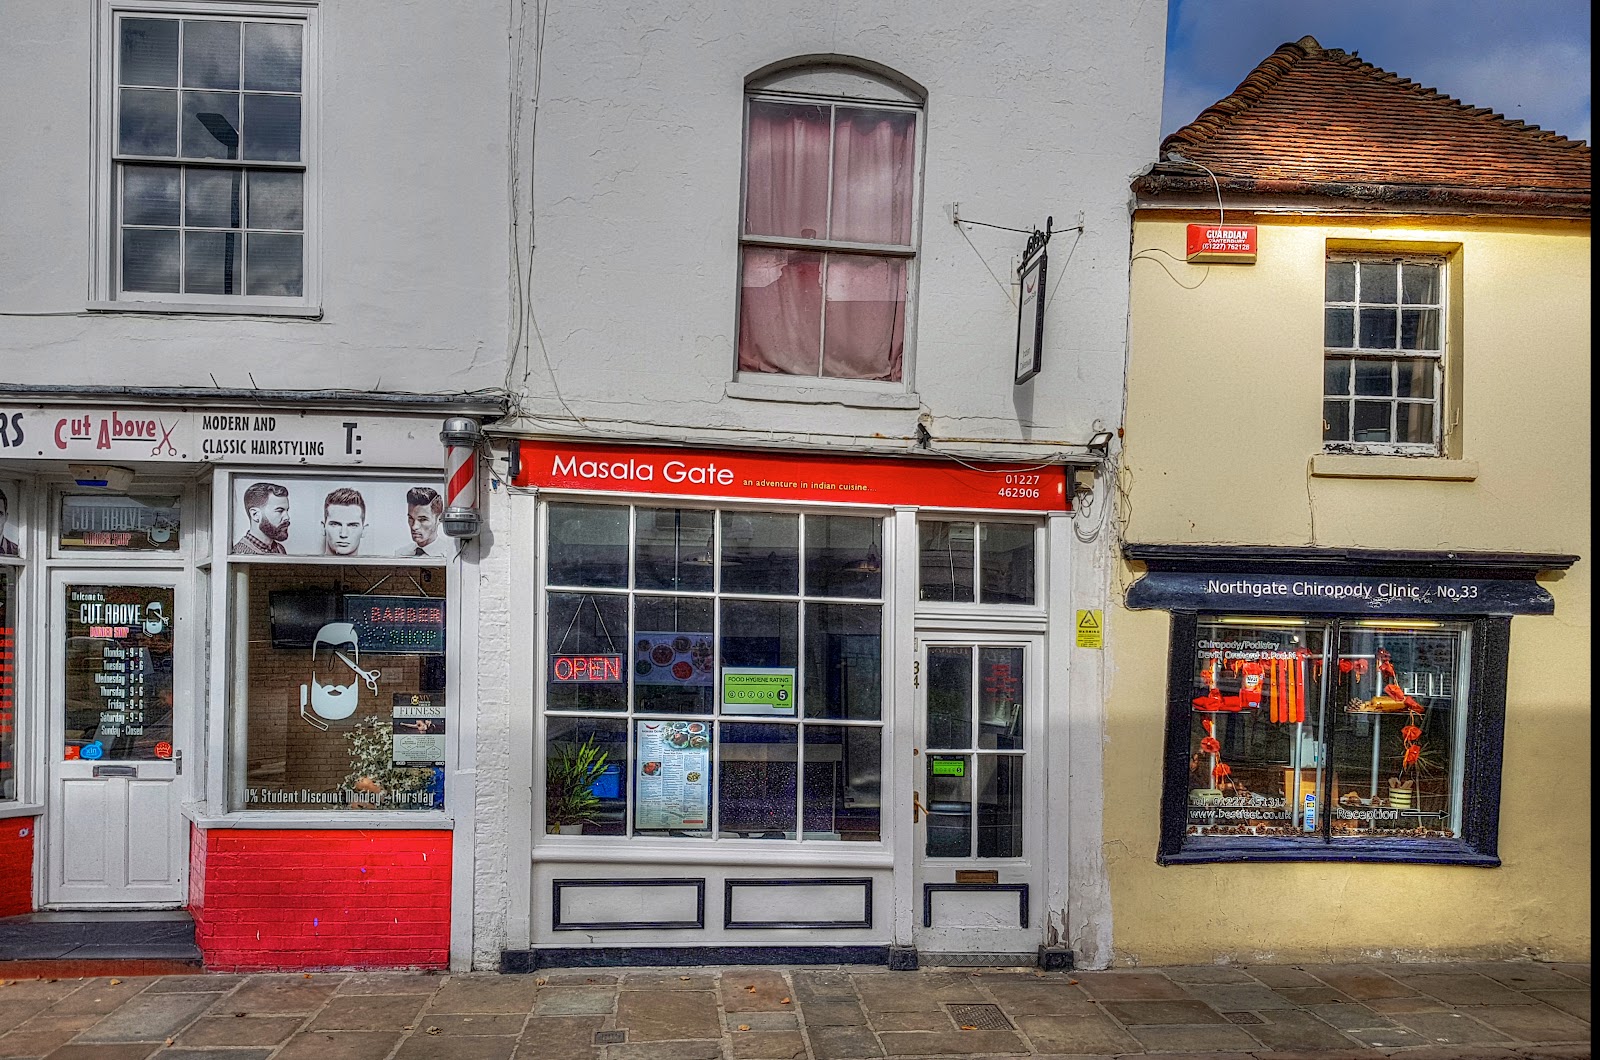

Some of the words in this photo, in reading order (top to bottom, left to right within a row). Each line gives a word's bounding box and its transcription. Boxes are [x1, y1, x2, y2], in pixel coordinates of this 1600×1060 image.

[1206, 230, 1248, 239] GUARDIAN
[1202, 243, 1226, 251] (01227)
[202, 415, 249, 431] MODERN
[253, 417, 276, 432] AND
[54, 414, 92, 450] Cut
[96, 411, 157, 450] Above
[342, 422, 362, 455] T:
[202, 439, 247, 454] CLASSIC
[251, 440, 324, 456] HAIRSTYLING
[551, 454, 654, 481] Masala
[662, 460, 735, 486] Gate
[755, 479, 798, 488] adventure
[811, 481, 836, 490] indian
[1005, 474, 1040, 485] 01227
[997, 487, 1040, 498] 462906
[72, 506, 96, 530] CUT
[101, 506, 146, 531] ABOVE
[1207, 580, 1287, 596] Northgate
[1292, 582, 1372, 599] Chiropody
[1377, 583, 1420, 597] Clinic
[1436, 585, 1478, 599] No.33
[71, 592, 96, 601] Welcome
[80, 603, 102, 624] CUT
[105, 604, 141, 625] ABOVE
[371, 607, 443, 623] BARBER
[389, 629, 437, 645] SHOP
[1198, 640, 1280, 651] Chiropody/Podiatry
[104, 647, 125, 660] Monday
[130, 647, 135, 658] 9
[139, 647, 144, 658] 6
[1198, 651, 1223, 659] David
[103, 660, 125, 673] Tuesday
[130, 660, 135, 671] 9
[139, 660, 144, 671] 6
[555, 657, 620, 680] OPEN
[95, 673, 125, 686] Wednesday
[130, 673, 135, 684] 9
[139, 673, 144, 684] 6
[100, 686, 125, 699] Thursday
[130, 686, 135, 697] 9
[139, 686, 144, 697] 6
[108, 699, 125, 712] Friday
[130, 699, 135, 710] 9
[139, 699, 144, 710] 6
[400, 707, 441, 715] FITNESS
[100, 712, 125, 725] Saturday
[130, 712, 135, 723] 9
[139, 712, 144, 723] 6
[101, 725, 121, 737] Sunday
[125, 725, 143, 736] Closed
[241, 788, 258, 803] 10%
[261, 789, 298, 803] Student
[301, 789, 342, 803] Discount
[346, 790, 381, 806] Monday
[392, 790, 435, 806] Thursday
[1213, 798, 1246, 806] 01227
[1190, 809, 1292, 820] www.bestfeet.co.uk
[1336, 808, 1398, 821] Reception
